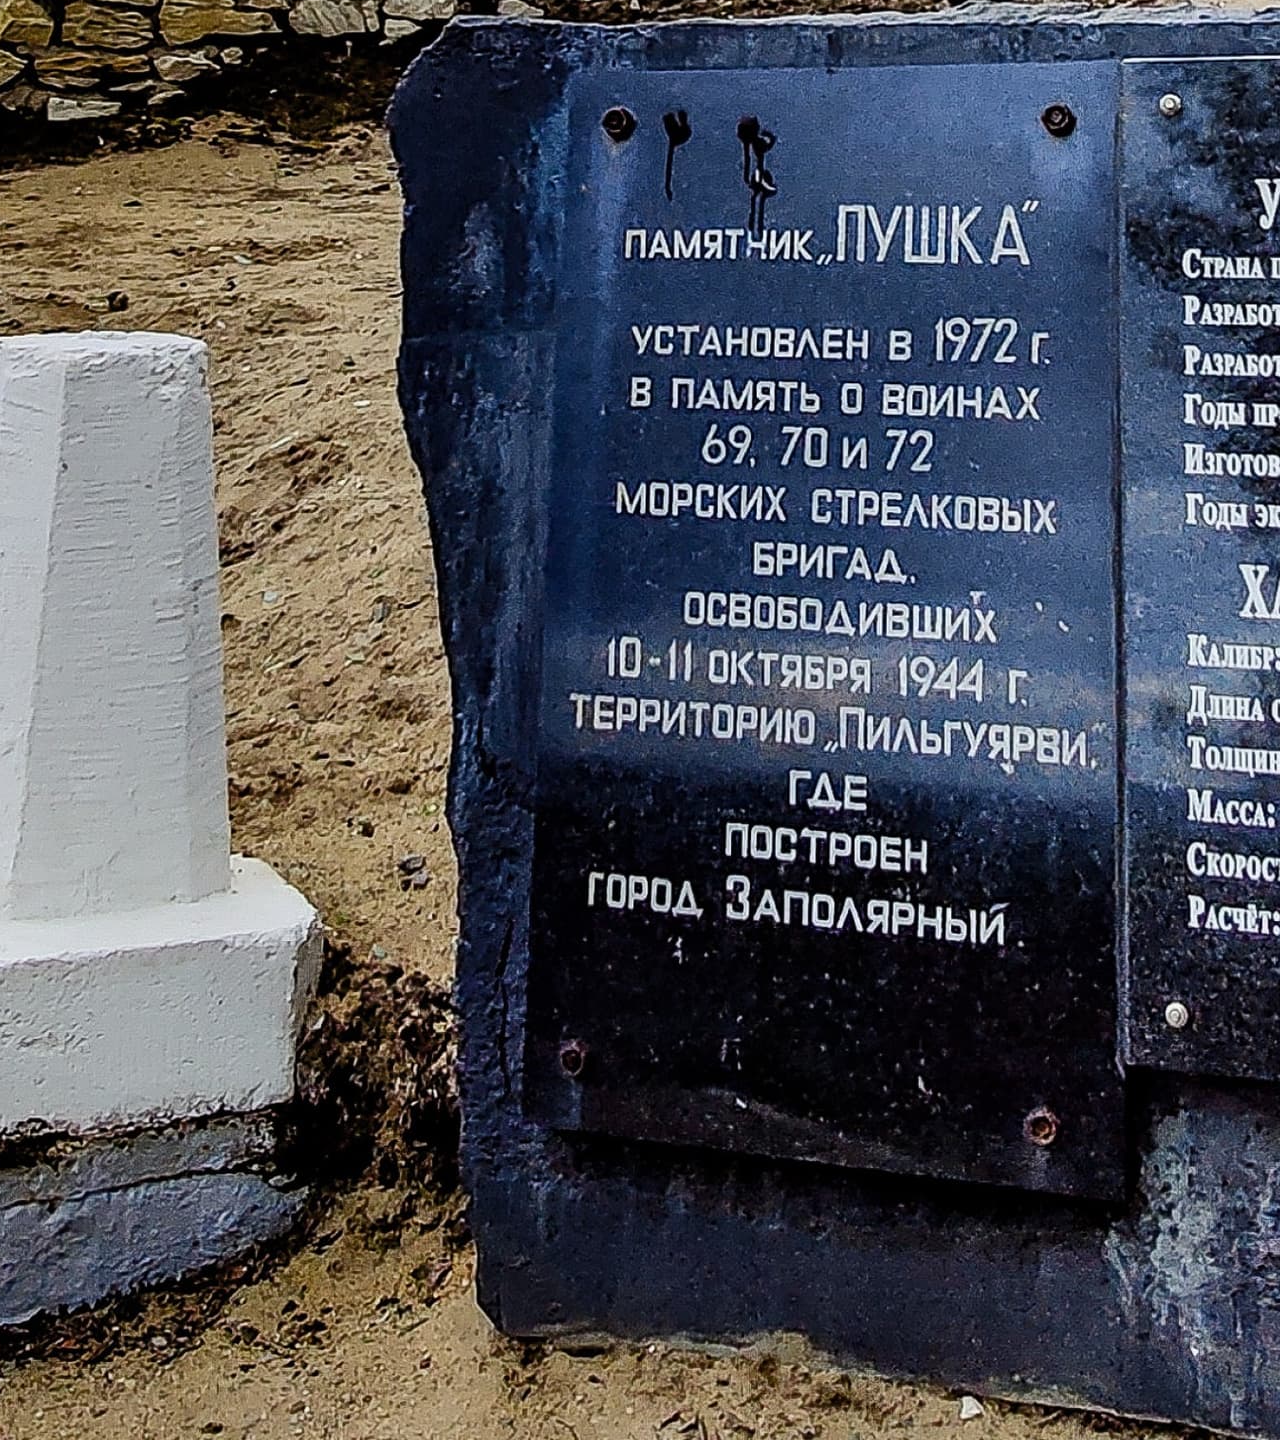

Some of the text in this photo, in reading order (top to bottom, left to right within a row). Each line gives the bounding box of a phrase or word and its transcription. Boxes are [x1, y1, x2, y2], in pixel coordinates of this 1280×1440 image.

[624, 228, 813, 261] ПАМЯТНИК
[631, 325, 868, 360] УСТАНОВЛЕН
[933, 317, 1018, 365] 1972
[630, 377, 652, 408] В
[670, 379, 820, 413] ПАМЯТЬ
[882, 384, 1040, 421] ВОИНАХ
[781, 426, 827, 469] 70
[884, 430, 933, 472] 72
[615, 481, 1057, 535] МОРСКИХ СТРЕЛКОВЫХ
[684, 591, 996, 643] ОСВОБОДИВШИХ
[708, 649, 871, 693] ОКТЯБРЯ
[899, 656, 984, 702] 1944
[570, 692, 815, 743] ТЕРРИТОРИЮ
[789, 769, 867, 811] ГДЕ
[725, 823, 928, 874] ПОСТРОЕН
[587, 871, 1010, 946] ГОРОД ЗАПОЛЯРНЫЙ
